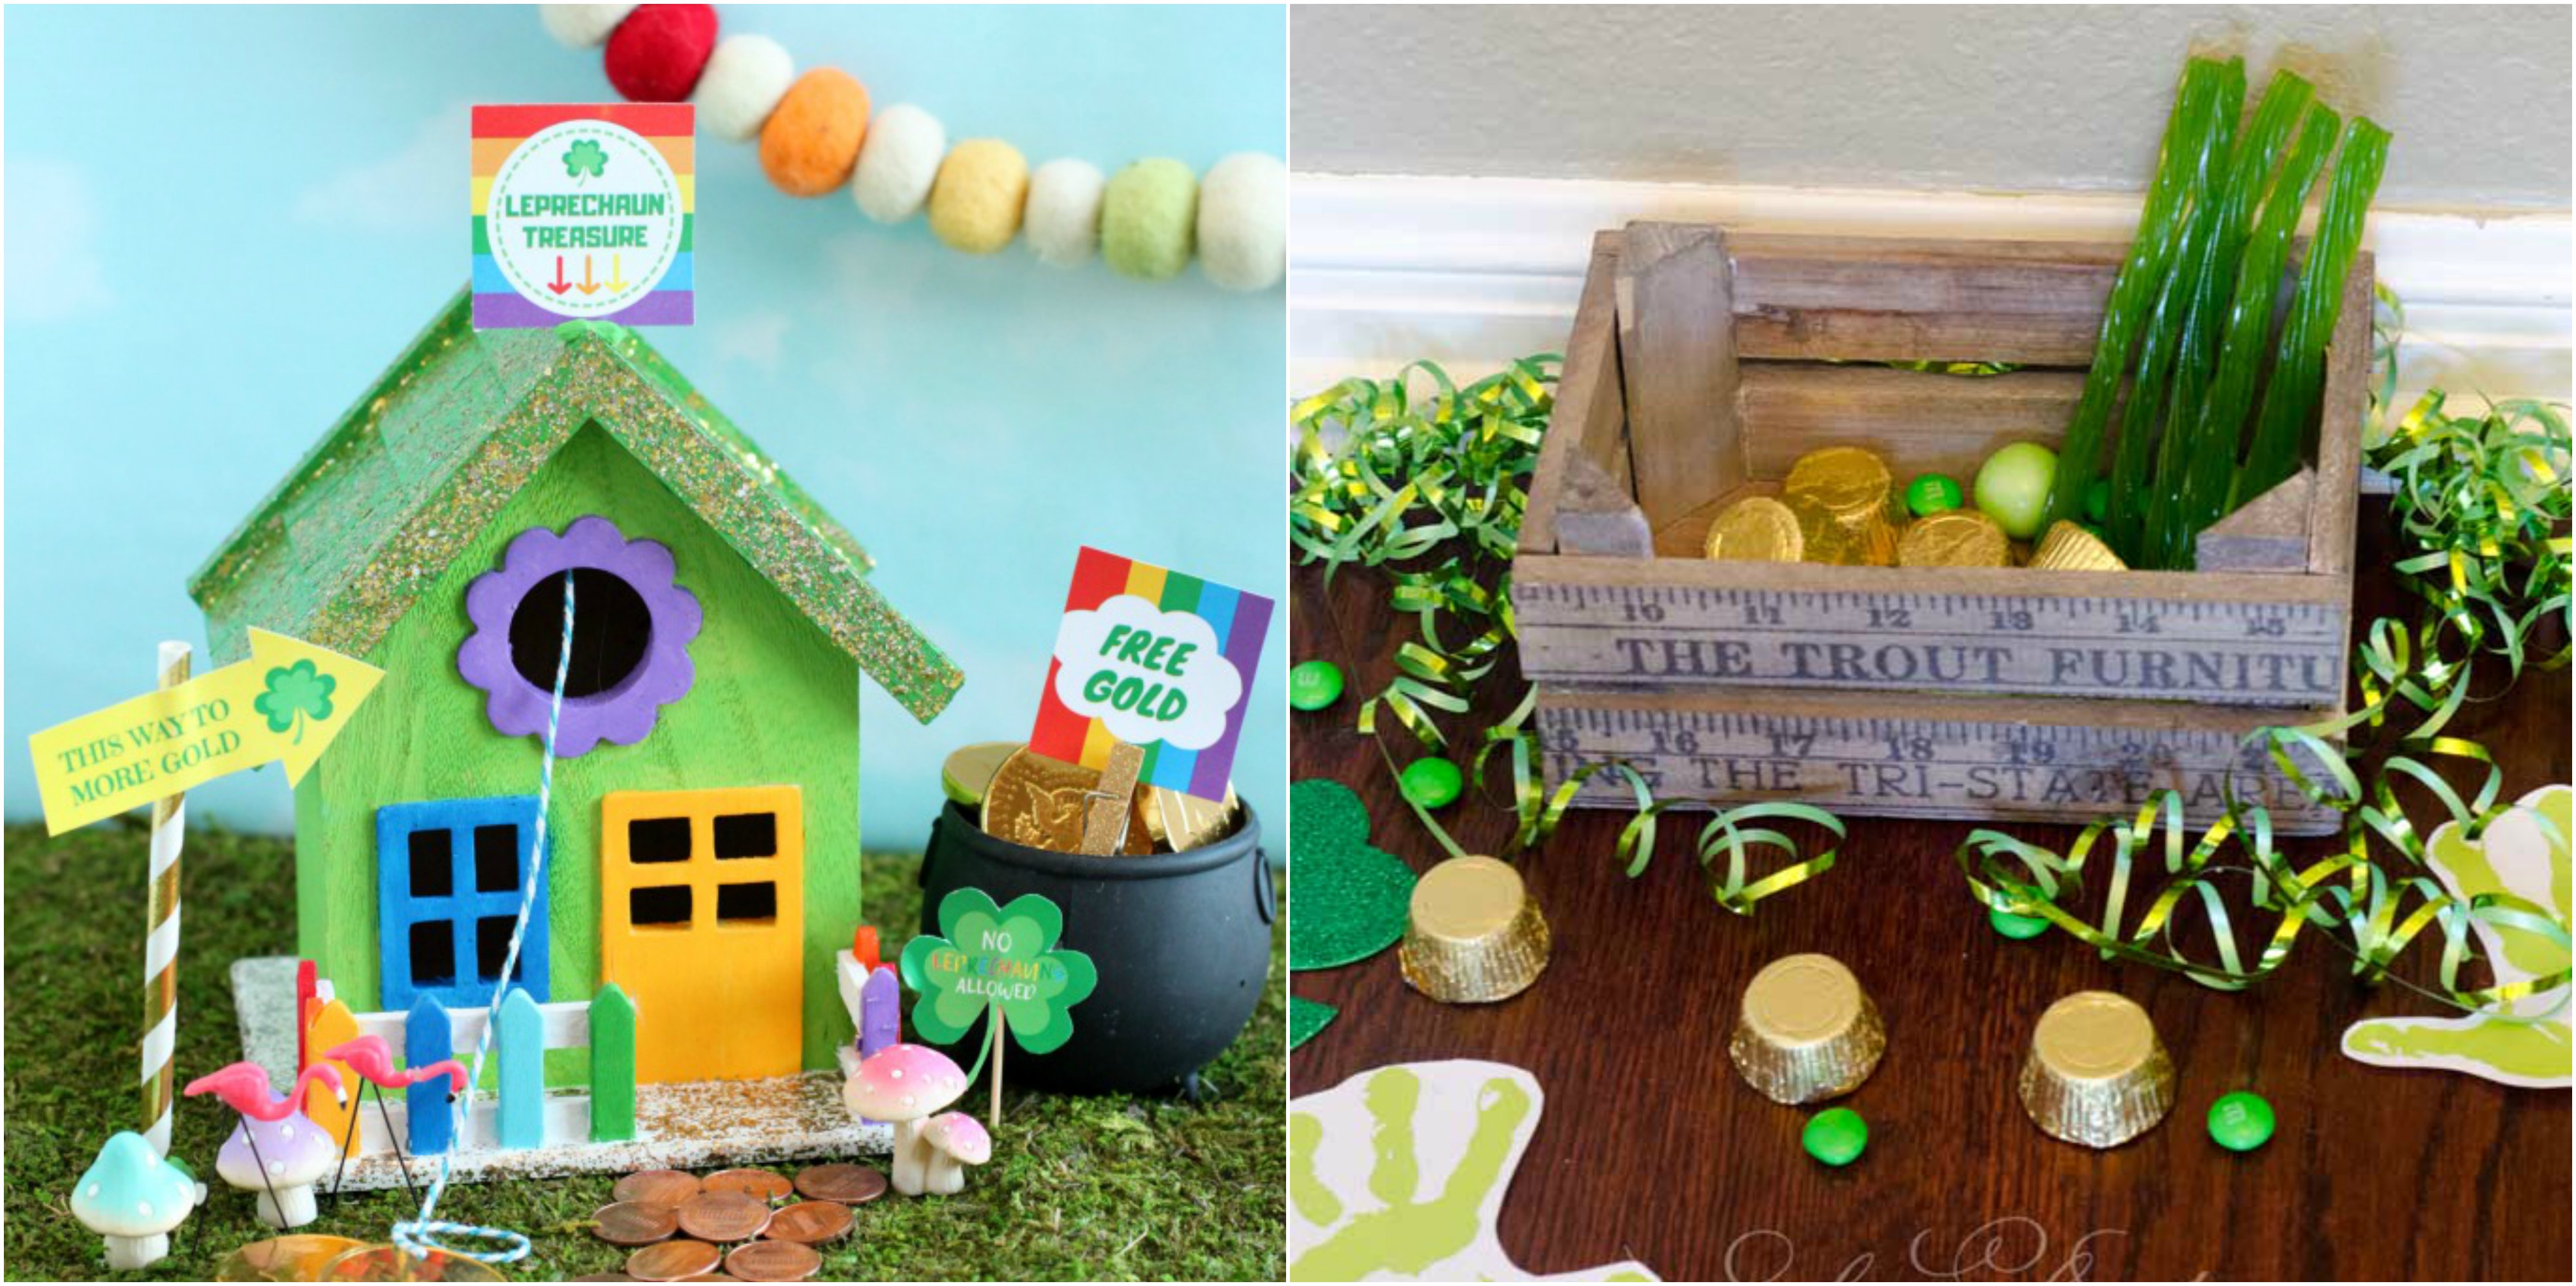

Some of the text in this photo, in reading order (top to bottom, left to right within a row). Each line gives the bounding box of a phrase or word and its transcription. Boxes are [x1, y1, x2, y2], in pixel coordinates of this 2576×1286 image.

[505, 193, 665, 217] LEPRECHAUN
[522, 225, 648, 248] TREASURE
[1623, 602, 1665, 622] 10
[1744, 604, 1785, 625] 11
[1869, 607, 1913, 629] 12
[1098, 624, 1198, 677] FREE
[1615, 637, 2340, 692] THE TROUT FURNITU
[1082, 669, 1188, 722] GOLD
[59, 698, 230, 775] THIS WAY TO
[1770, 733, 1815, 758] 17
[1887, 737, 1935, 762] 18
[2007, 740, 2057, 766] 19
[69, 730, 242, 807] MORE GOLD
[1690, 757, 1804, 792] THE
[982, 930, 1012, 952] NO
[956, 977, 1036, 1000] ALLOWED
